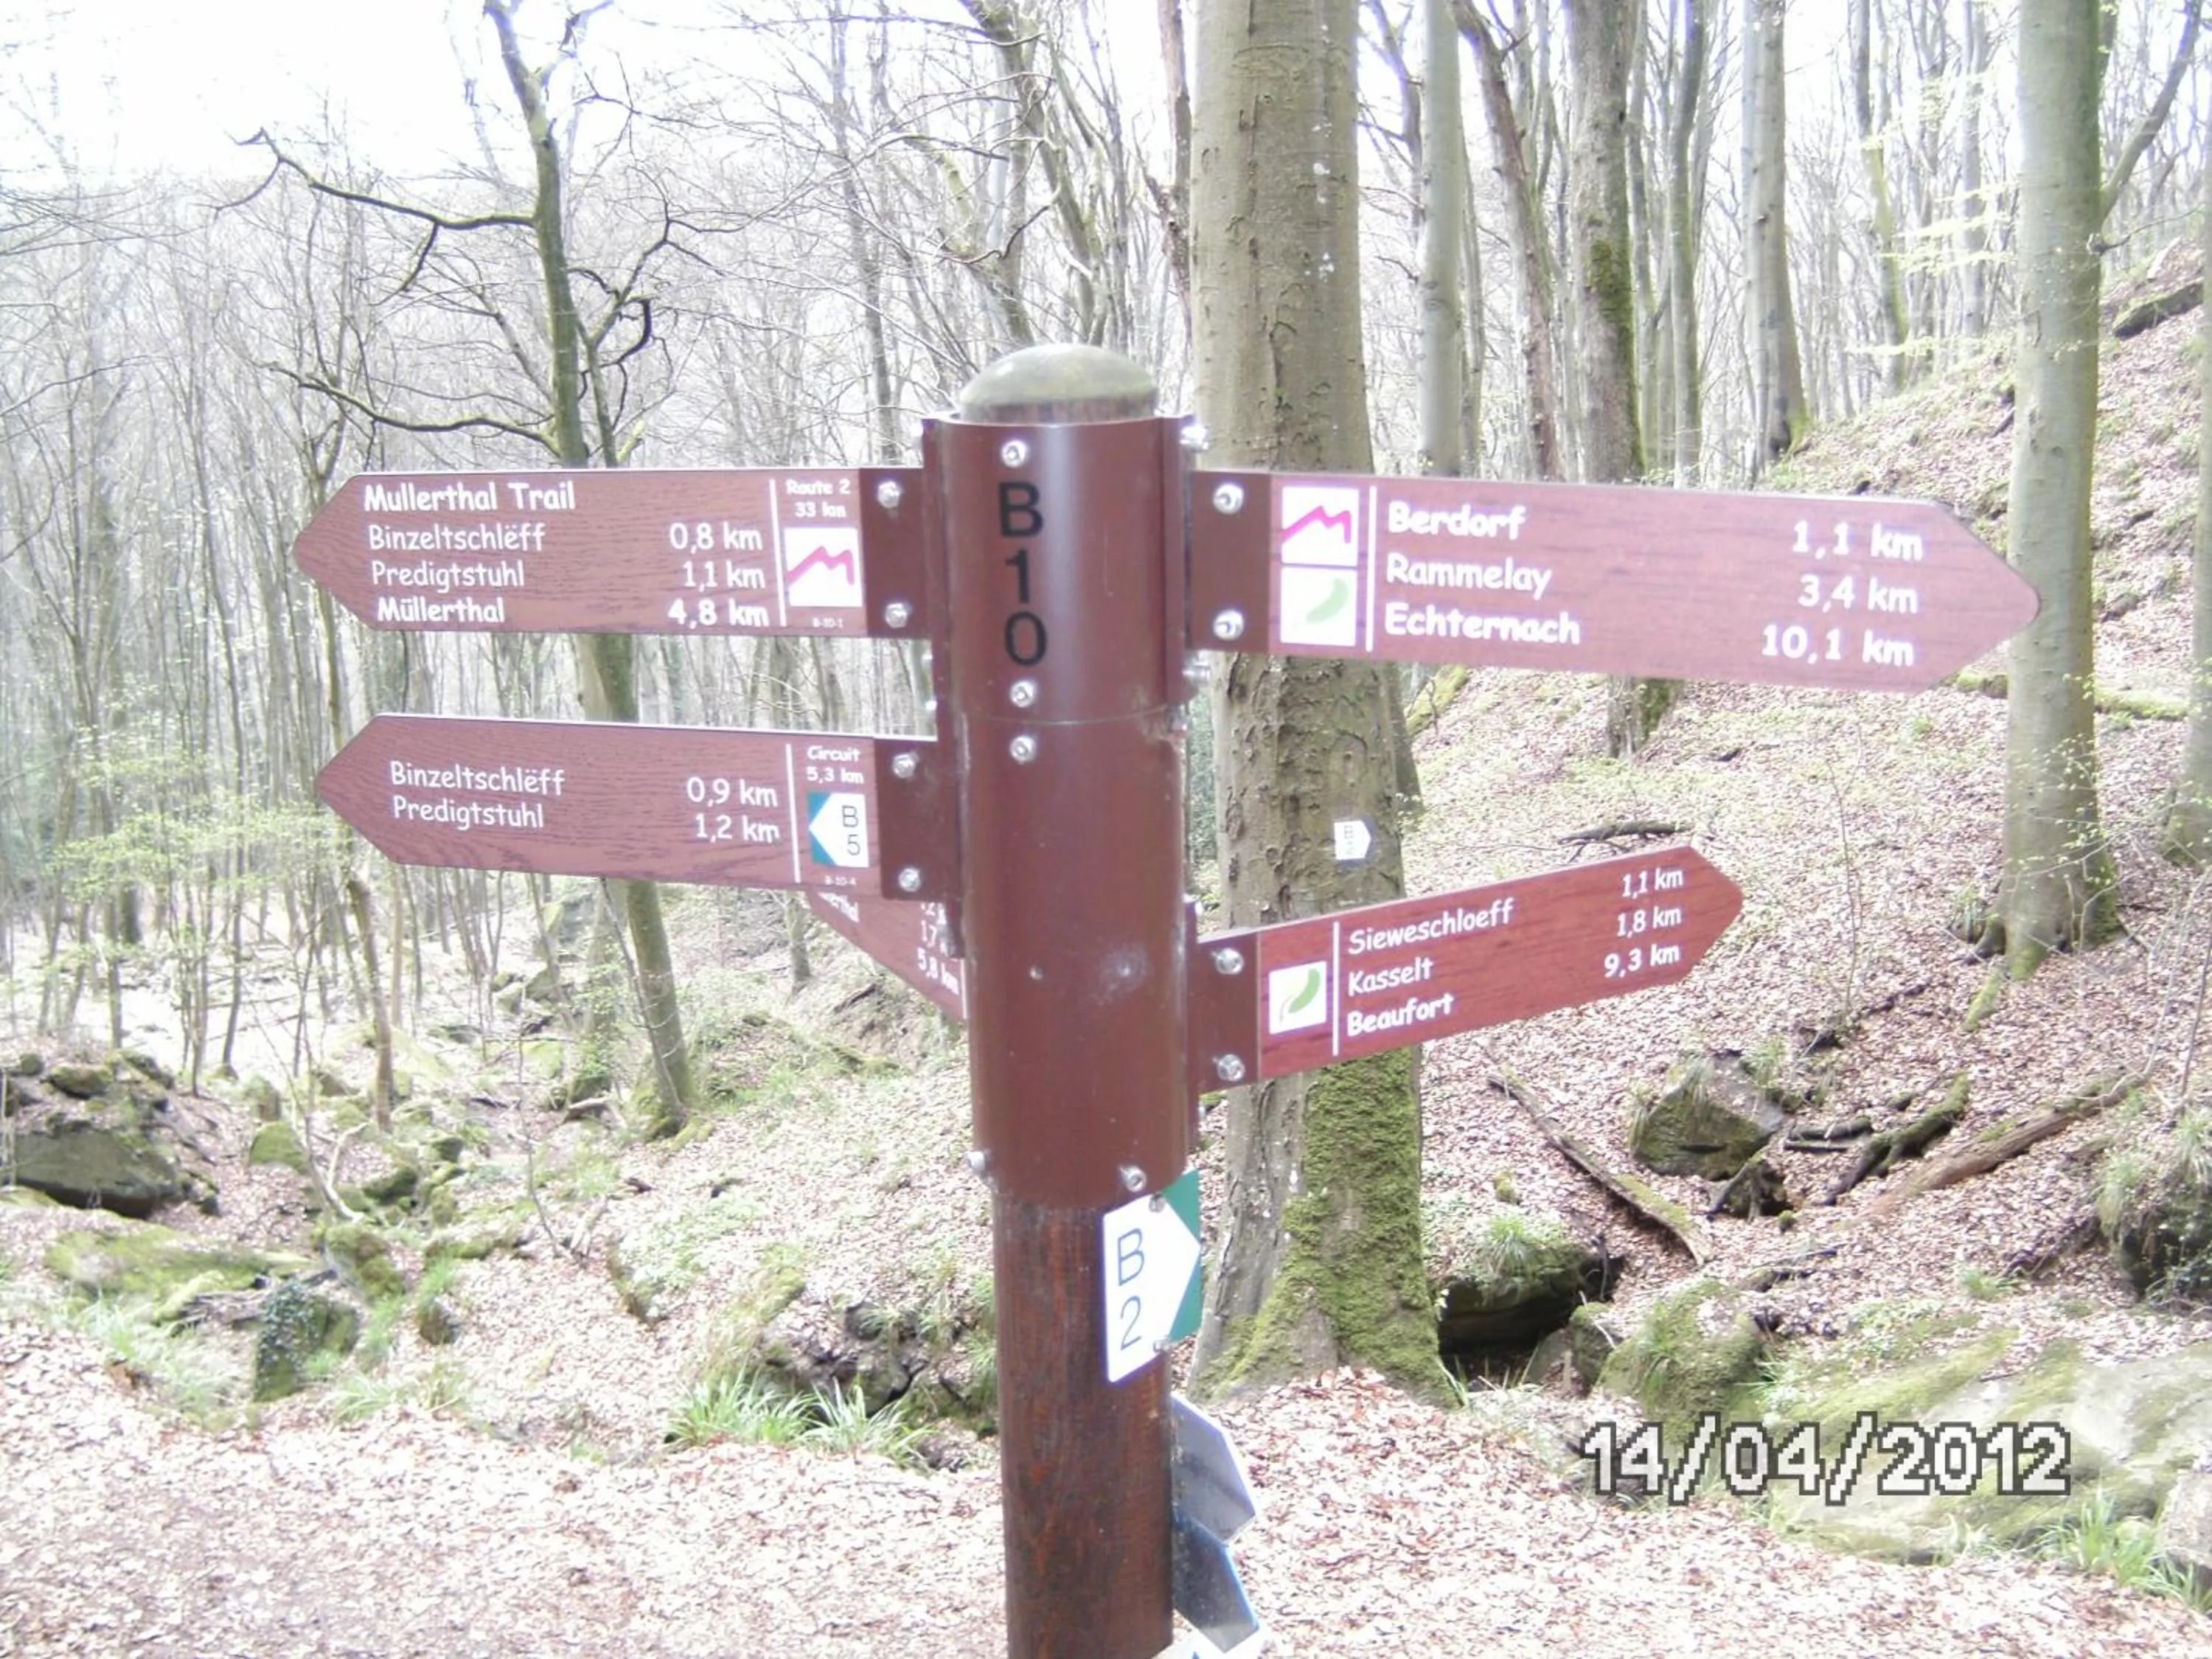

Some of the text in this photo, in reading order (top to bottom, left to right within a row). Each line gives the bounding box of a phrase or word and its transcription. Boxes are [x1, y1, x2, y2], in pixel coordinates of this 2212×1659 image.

[364, 480, 575, 511] Mullerthal Trail
[785, 479, 851, 495] Route 2
[794, 501, 846, 518] 33 km
[1388, 500, 1526, 540] Berdorf
[369, 521, 762, 554] Binzeltschlëff 0,8 km
[1792, 520, 1923, 561] 1,1 km
[372, 560, 765, 593] Predigtstuhl 1,1 km
[1386, 552, 1918, 613] Rammelay 3,4 km
[378, 596, 769, 628] Müllerthal 4,8 km
[1384, 602, 1913, 667] Echternach 10,1 km
[807, 745, 860, 762] Circuit
[390, 760, 777, 807] Binzeltschlëff 0,9 km
[807, 766, 864, 784] 5,3 km
[393, 795, 779, 844] Predigtstuhl 1,2 km
[1348, 868, 1683, 955] Sieweschloeff 1,1 km
[1349, 905, 1682, 997] Kasselt 1,8 km
[1347, 944, 1680, 1037] Beaufort 9,3 km
